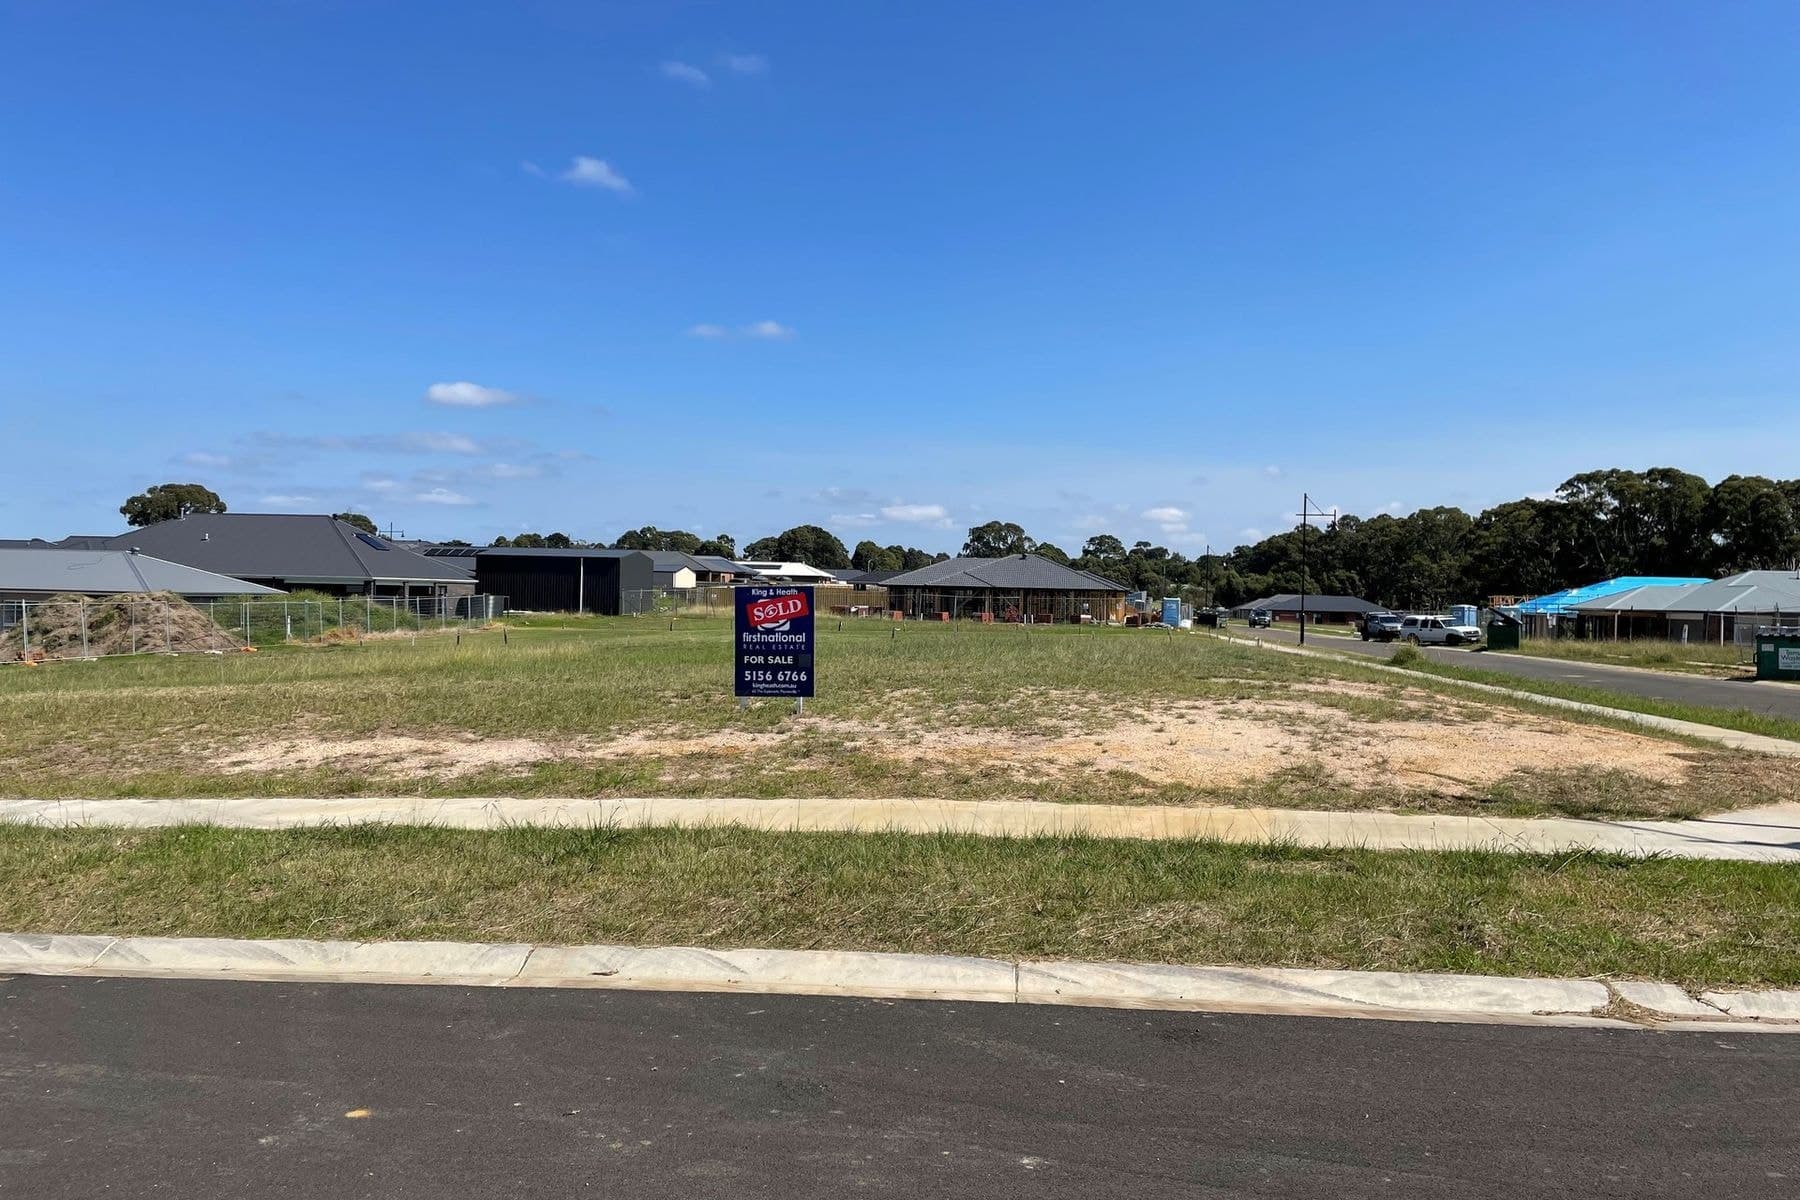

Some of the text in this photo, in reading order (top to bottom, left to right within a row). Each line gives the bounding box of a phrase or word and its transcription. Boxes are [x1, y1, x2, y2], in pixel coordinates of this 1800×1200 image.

[751, 588, 798, 597] King & Heath
[753, 599, 802, 621] SOLD
[744, 655, 794, 664] FOR SALE
[744, 670, 807, 681] 5156 6766
